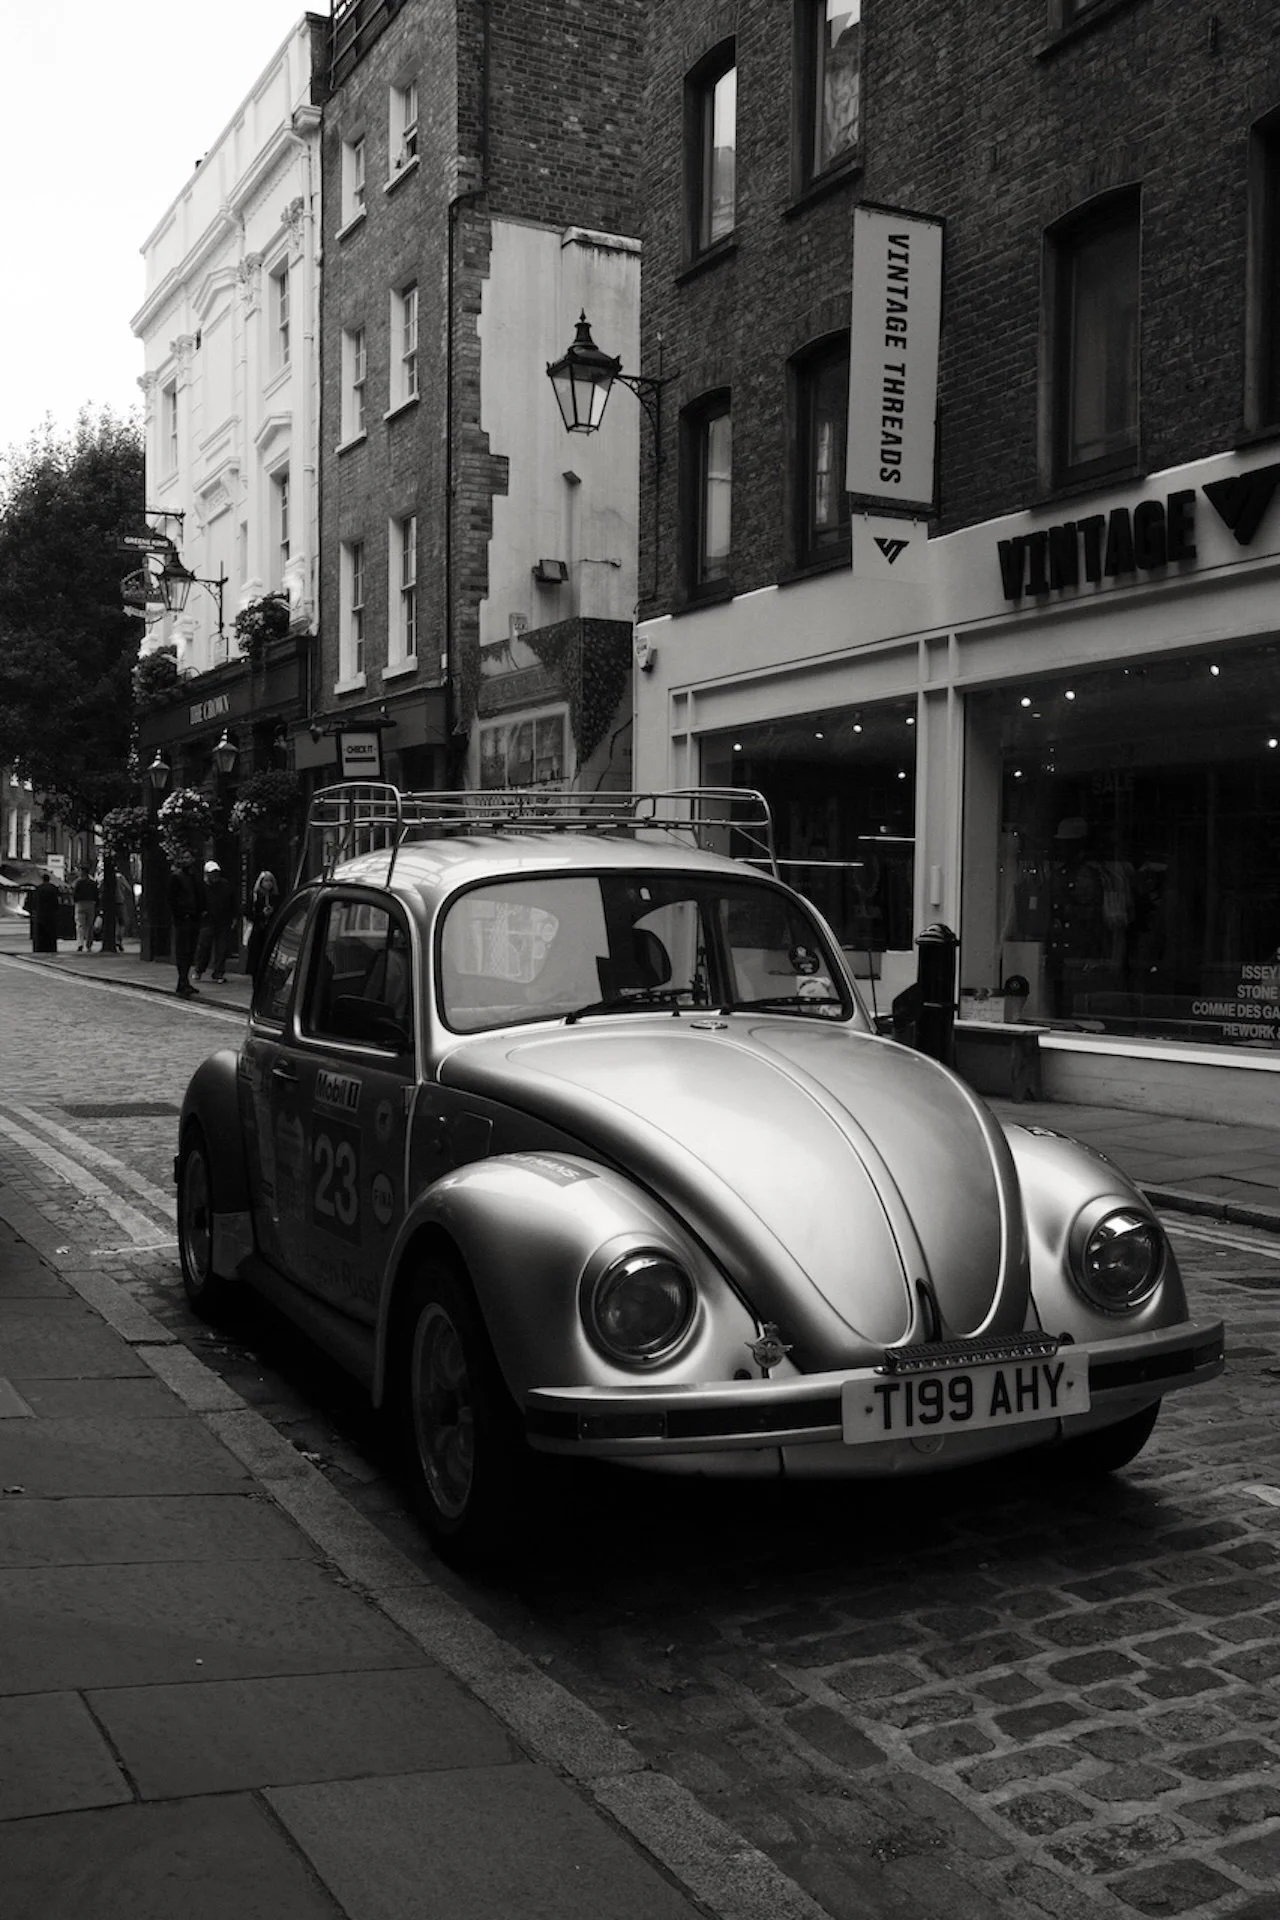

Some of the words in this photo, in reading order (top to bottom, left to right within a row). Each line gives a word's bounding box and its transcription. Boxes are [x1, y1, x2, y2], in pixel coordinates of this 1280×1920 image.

[884, 233, 911, 349] VINTAGE
[879, 362, 906, 484] THREADS
[997, 489, 1197, 601] VINTAGE
[1236, 984, 1279, 1000] STONE
[1241, 964, 1277, 980] ISSEY
[1191, 1000, 1236, 1017] COMME
[1237, 1003, 1261, 1019] DES
[1222, 1022, 1275, 1039] REWORK
[316, 1072, 347, 1105] Mobil
[313, 1132, 358, 1226] 23
[874, 1375, 973, 1430] T199
[990, 1362, 1065, 1416] AHY
